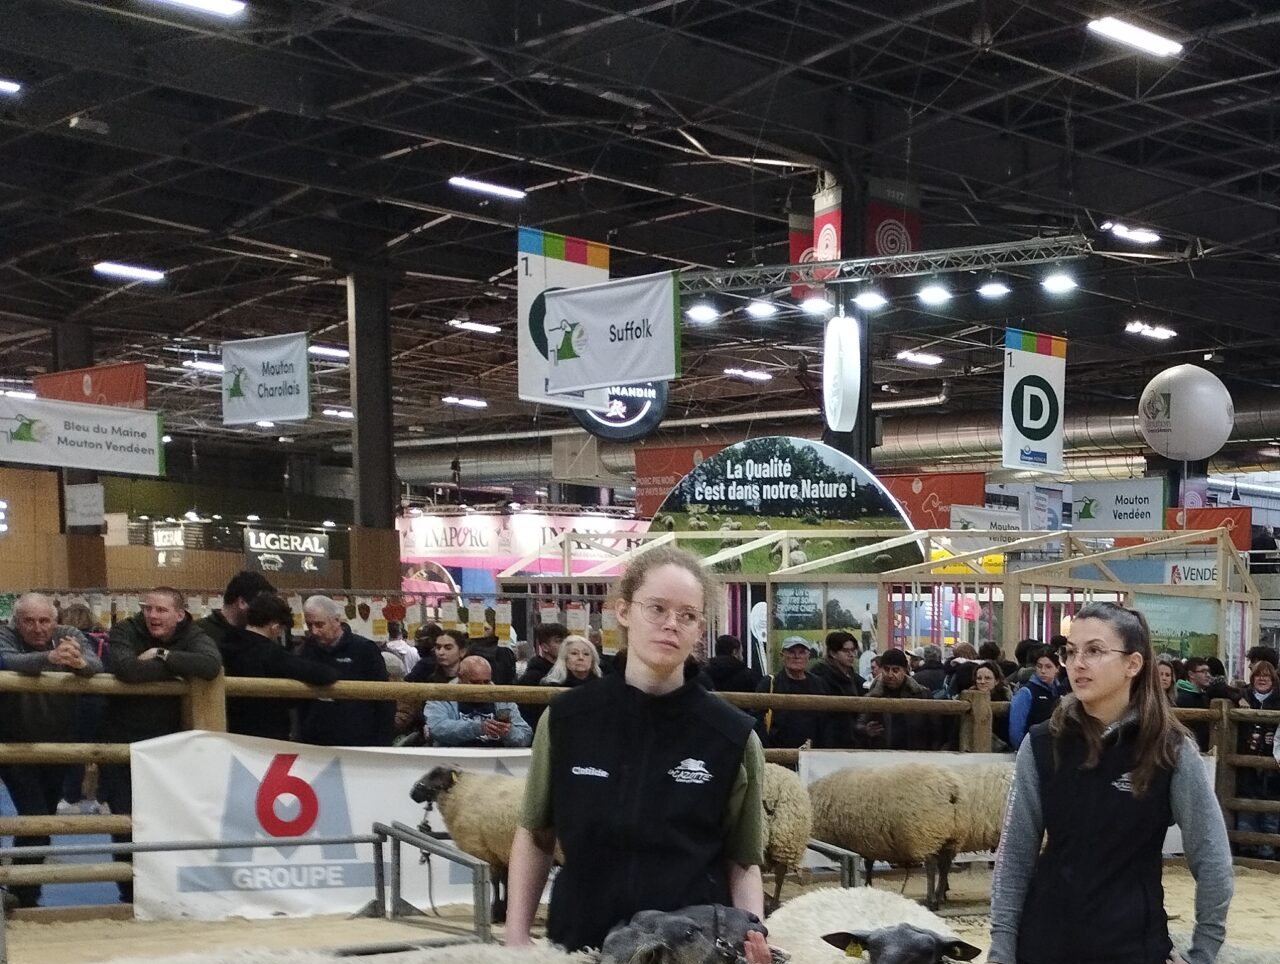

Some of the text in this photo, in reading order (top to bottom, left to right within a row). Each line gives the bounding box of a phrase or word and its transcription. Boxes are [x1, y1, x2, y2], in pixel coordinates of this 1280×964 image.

[609, 319, 652, 343] Suffolk
[261, 362, 294, 377] Mouton
[257, 383, 300, 398] Charollais
[1022, 385, 1049, 429] D
[64, 421, 147, 439] Bleu du Maine
[57, 436, 155, 455] Mouton Vendéen
[726, 458, 792, 480] La Qualité
[695, 478, 856, 501] c'est dans notre Nature !
[1115, 495, 1149, 505] Mouton
[1113, 509, 1151, 519] Vendéen
[249, 531, 326, 553] LIGERAL
[424, 526, 489, 548] INAPORC
[232, 866, 345, 889] GROUPE
